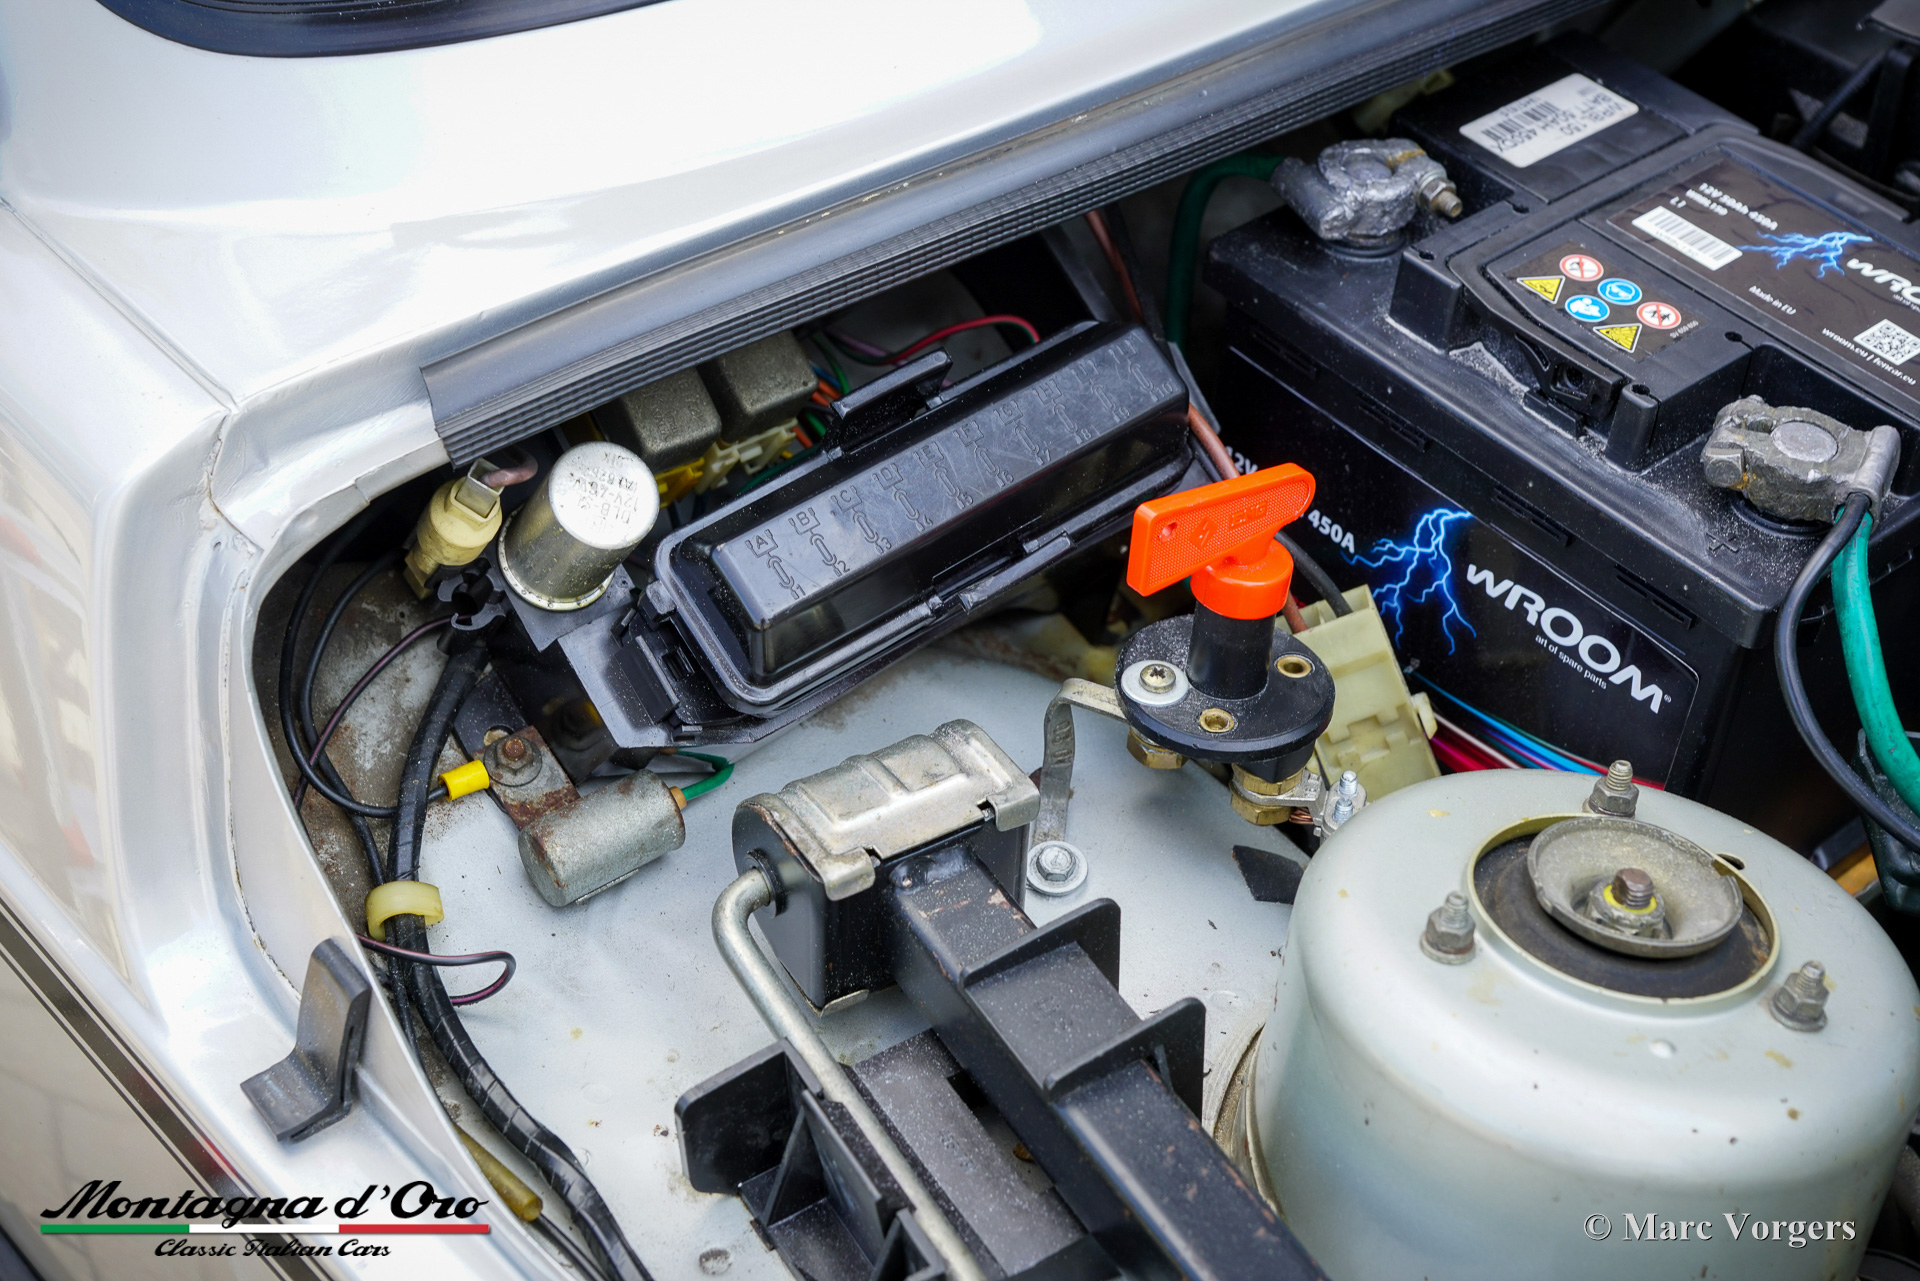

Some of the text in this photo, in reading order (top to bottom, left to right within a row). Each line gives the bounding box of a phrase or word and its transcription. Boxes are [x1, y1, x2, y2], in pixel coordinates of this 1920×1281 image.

[1749, 285, 1797, 315] Made in EU
[1822, 327, 1868, 358] wroom.eu
[755, 535, 769, 549] A
[796, 511, 811, 525] B
[840, 490, 852, 503] C
[881, 467, 893, 481] D
[922, 445, 935, 459] E
[1308, 509, 1355, 554] 450A
[838, 560, 850, 573] 2
[880, 537, 892, 550] 3
[1535, 634, 1607, 690] art of spare parts
